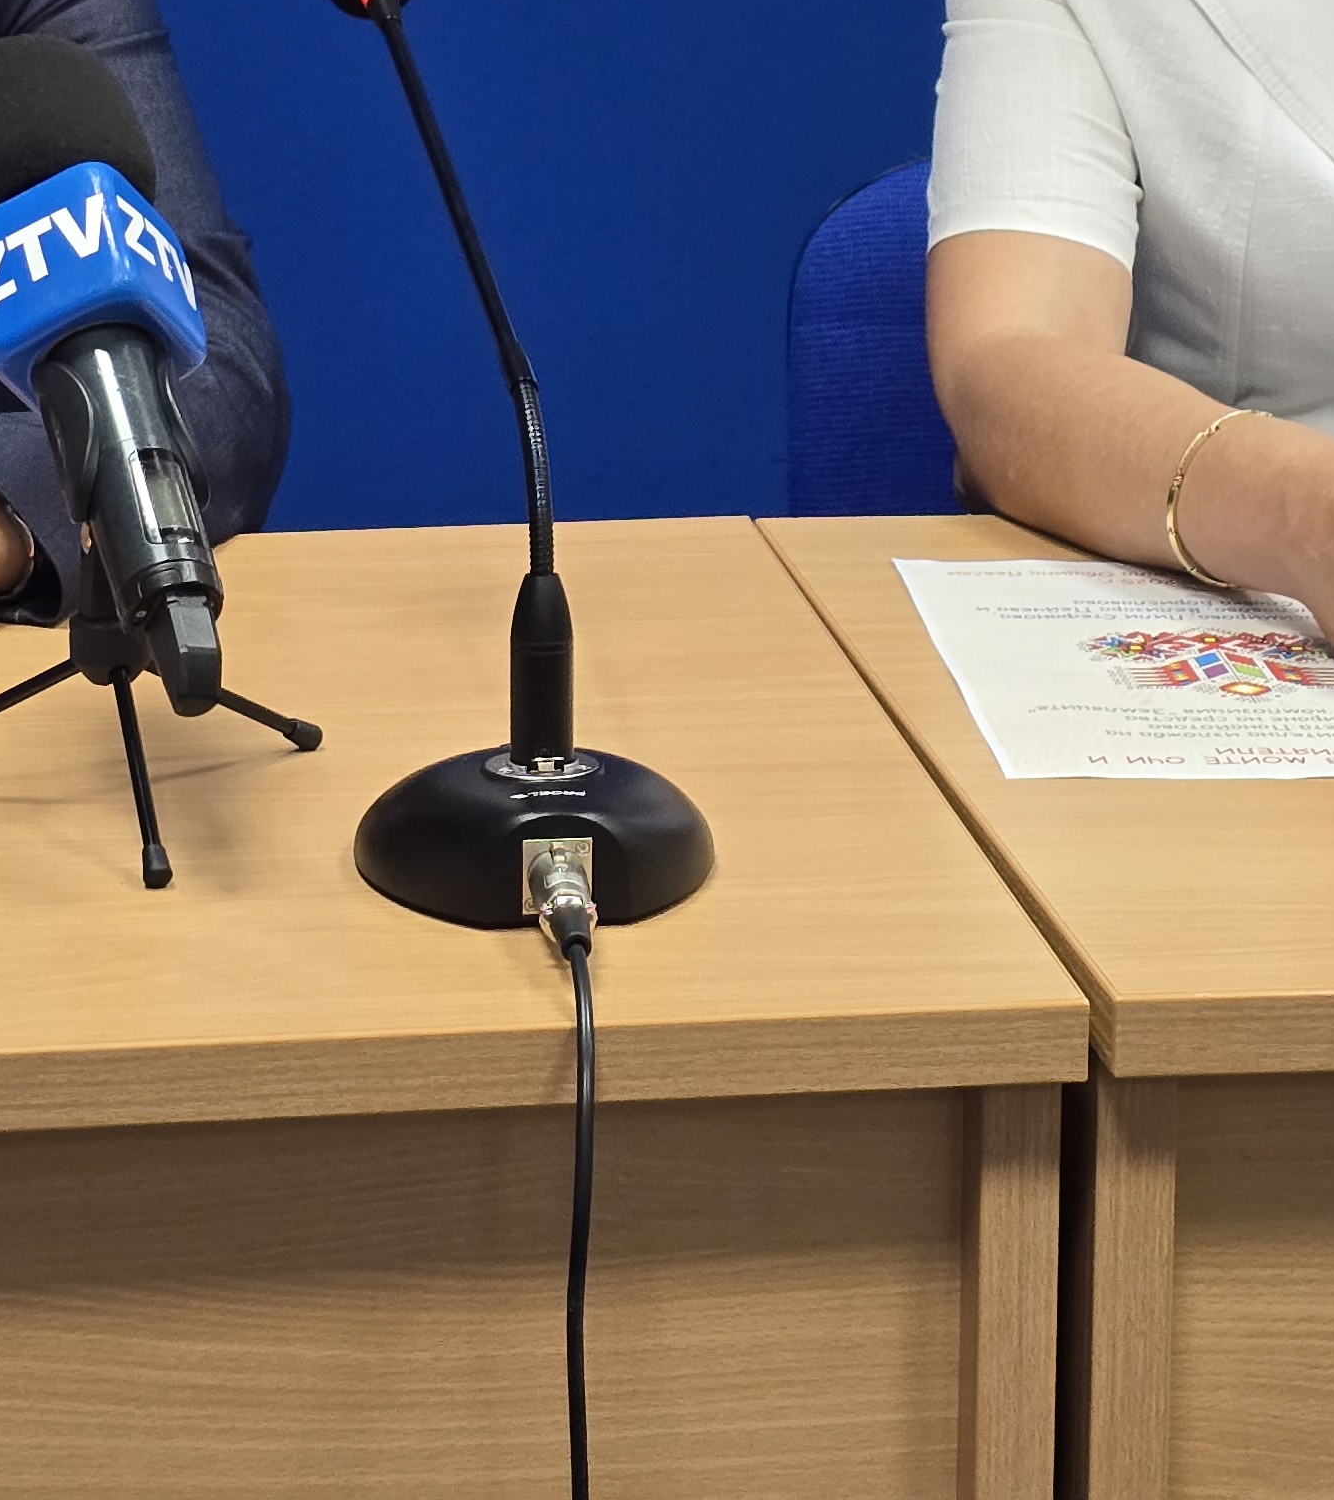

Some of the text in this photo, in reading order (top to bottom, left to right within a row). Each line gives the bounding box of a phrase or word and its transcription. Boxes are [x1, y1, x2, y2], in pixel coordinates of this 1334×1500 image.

[116, 195, 197, 311] ZTV
[1088, 756, 1109, 765] И
[1126, 756, 1186, 765] ОЧИ
